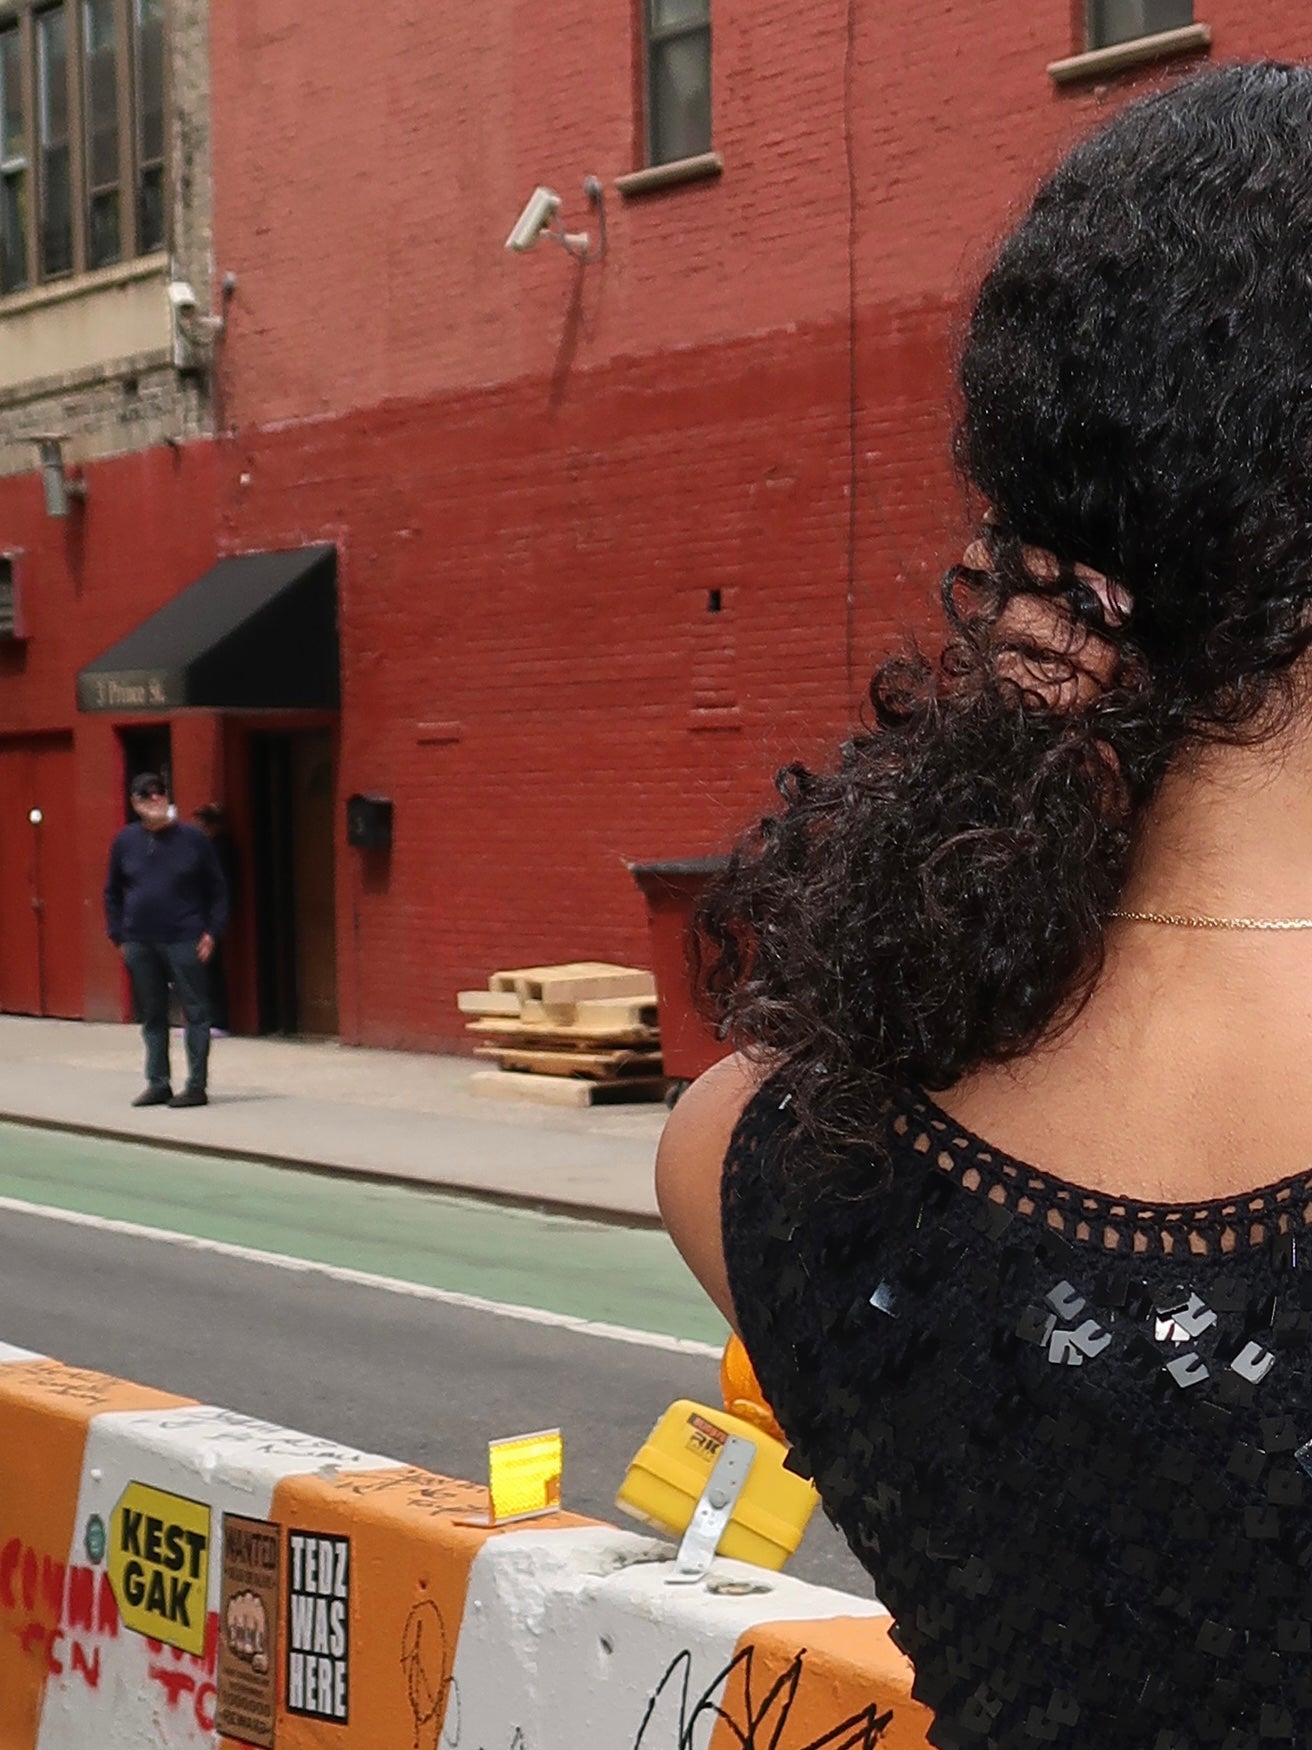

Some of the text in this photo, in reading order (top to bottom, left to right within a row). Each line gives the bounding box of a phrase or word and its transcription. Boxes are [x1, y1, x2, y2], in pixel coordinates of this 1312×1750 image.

[121, 1507, 206, 1578] KEST
[290, 1535, 348, 1598] TEDZ
[124, 1560, 193, 1627] GAK
[291, 1593, 346, 1658] WAS
[288, 1652, 347, 1718] HERE
